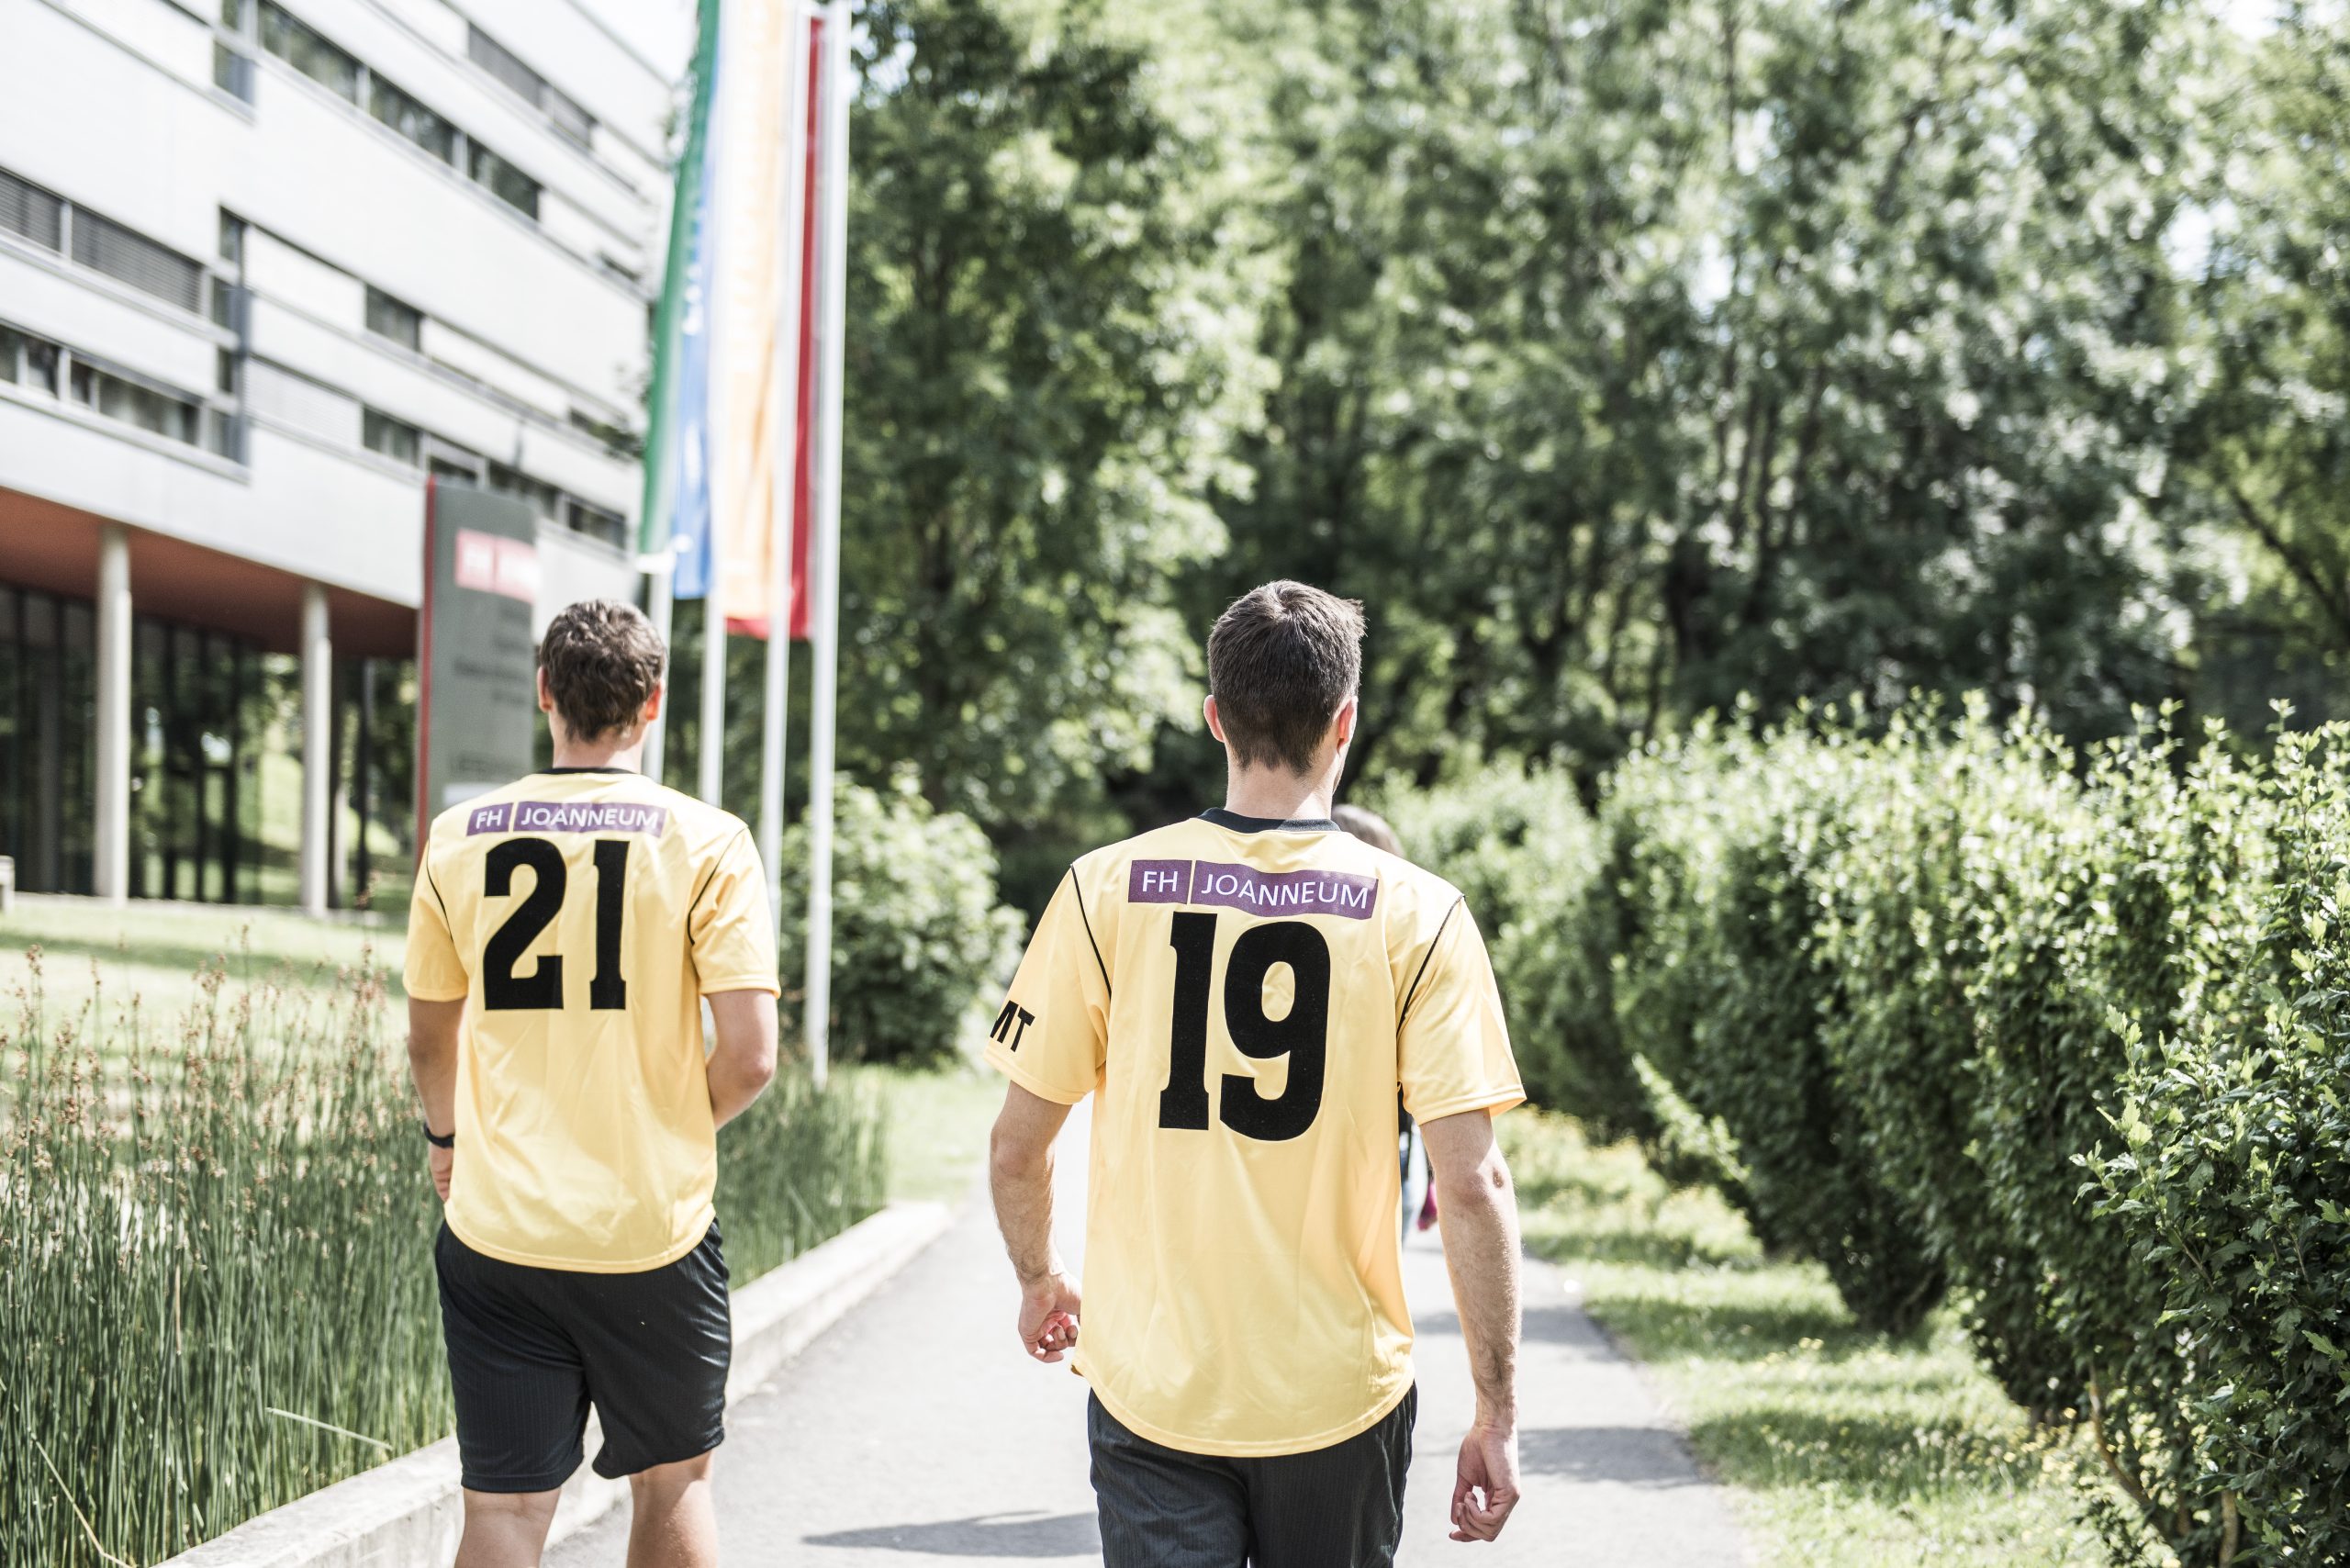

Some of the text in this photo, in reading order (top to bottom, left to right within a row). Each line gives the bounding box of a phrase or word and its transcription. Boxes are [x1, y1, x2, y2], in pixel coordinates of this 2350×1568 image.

[476, 807, 660, 830] FH JOANNEUM
[483, 837, 631, 1011] 21
[1142, 870, 1369, 909] FH JOANNEUM
[1158, 911, 1331, 1141] 19
